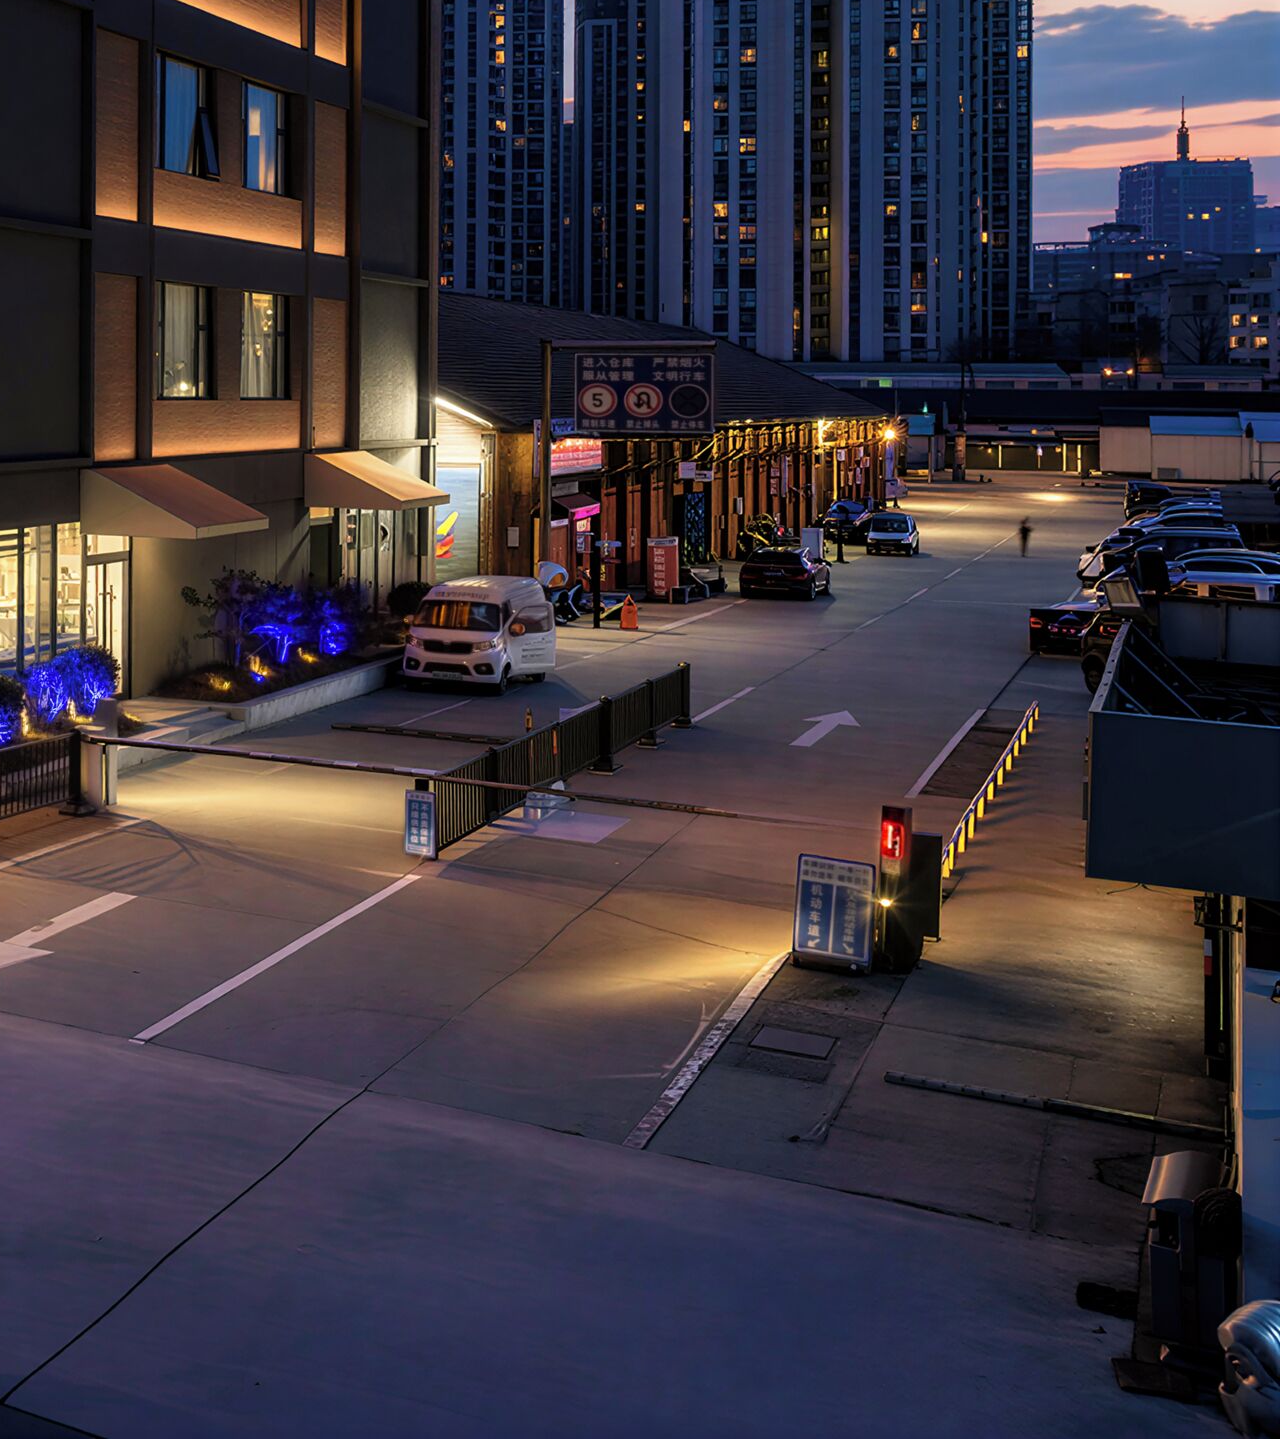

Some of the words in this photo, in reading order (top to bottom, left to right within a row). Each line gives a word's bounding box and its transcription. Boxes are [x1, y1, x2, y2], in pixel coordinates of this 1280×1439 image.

[582, 357, 635, 368] 进入仓库
[652, 357, 705, 368] 严禁烟火
[582, 370, 635, 382] 服从管理
[652, 370, 705, 382] 文明行车
[592, 392, 603, 408] 5
[807, 884, 824, 937] 机动车道
